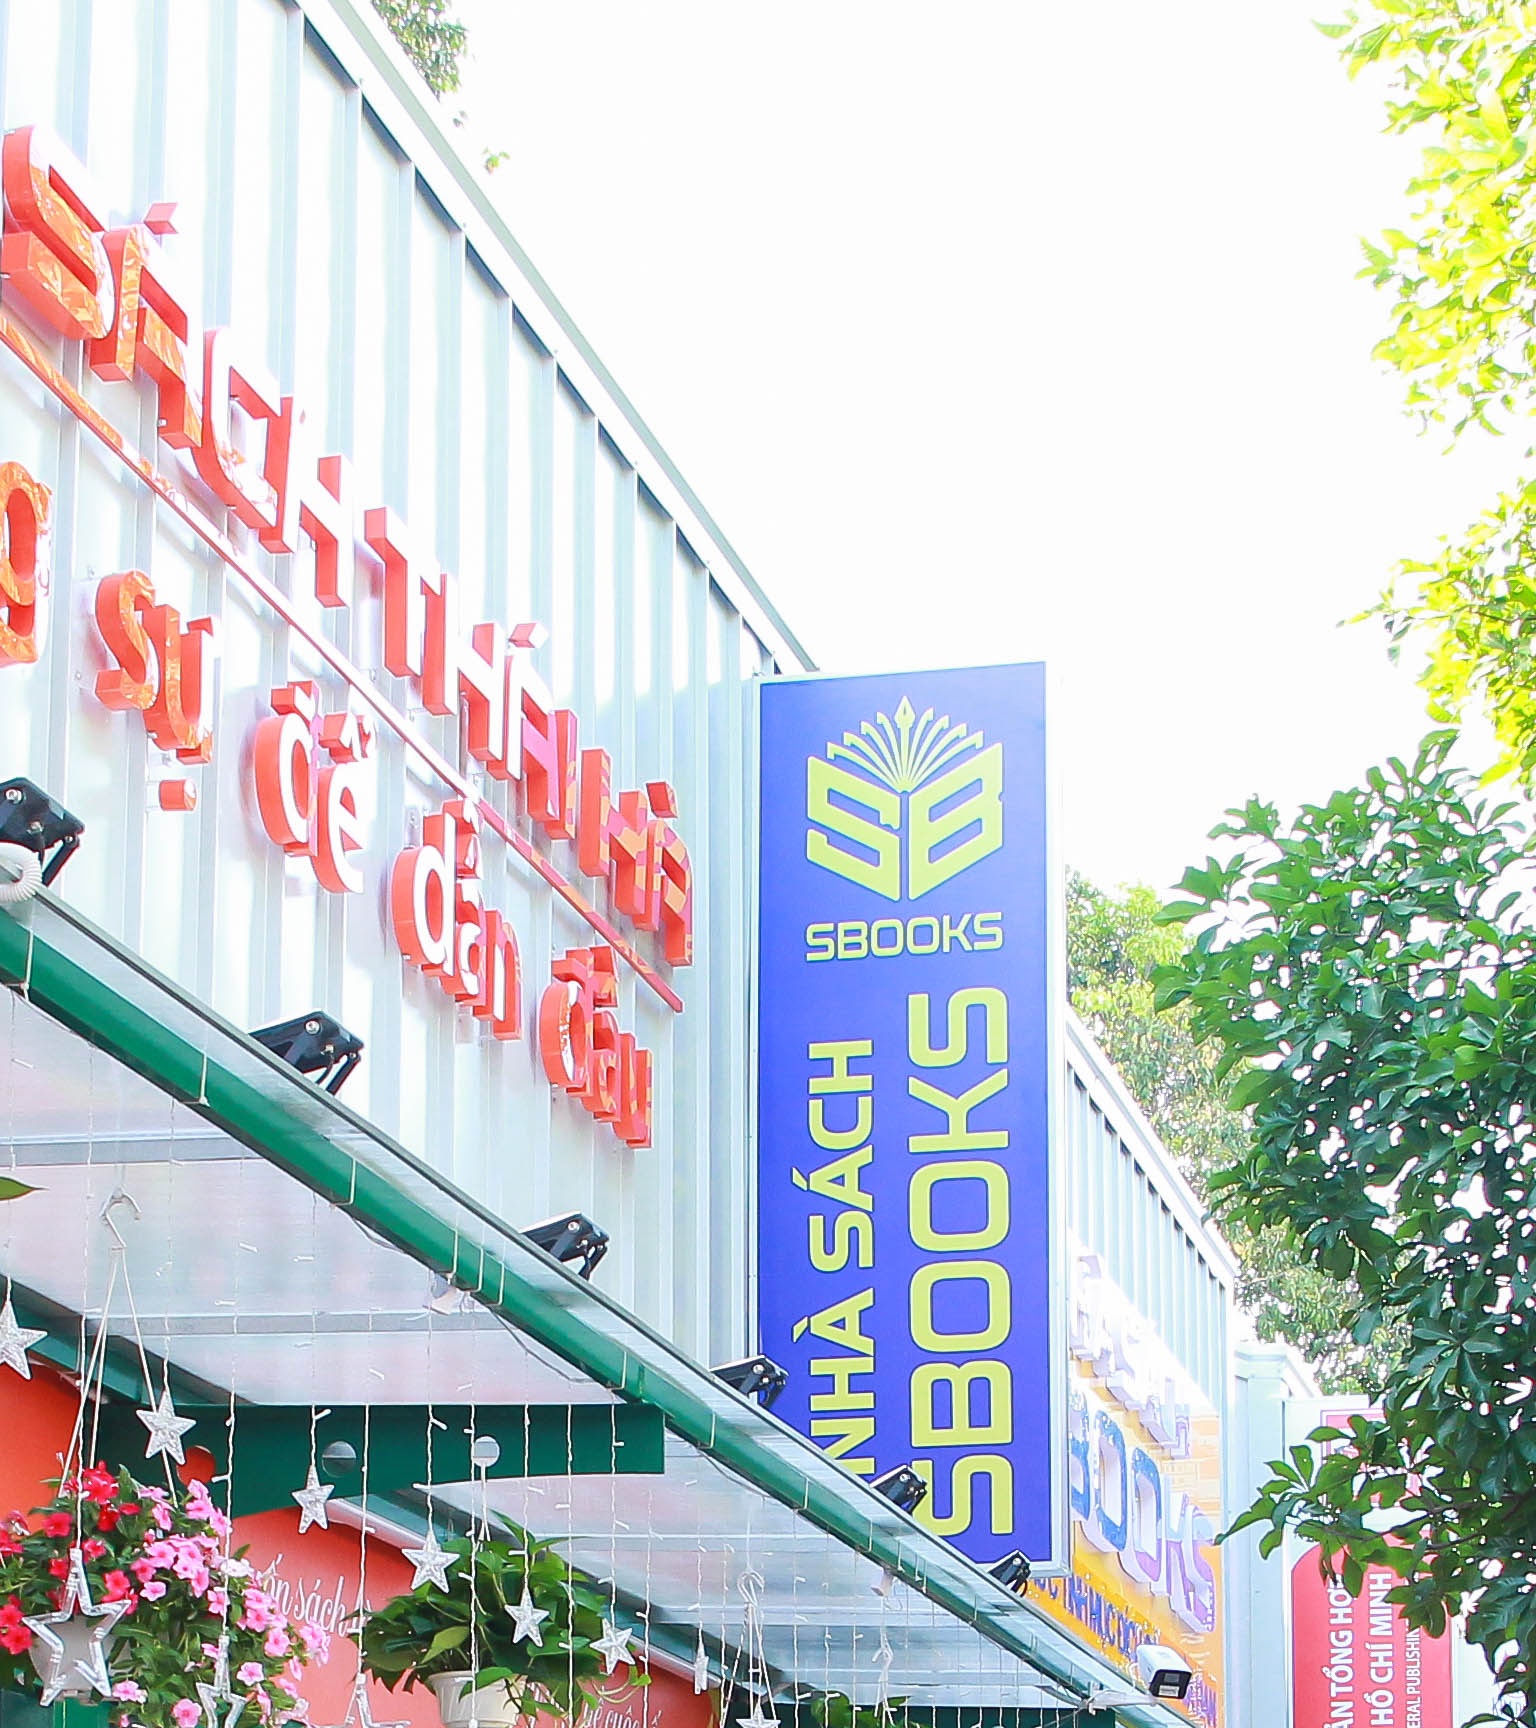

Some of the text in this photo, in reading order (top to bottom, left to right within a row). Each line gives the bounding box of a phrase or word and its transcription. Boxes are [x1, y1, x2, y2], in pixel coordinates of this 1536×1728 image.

[0, 120, 352, 608] SÁCH
[94, 568, 215, 812] sự
[254, 681, 376, 895] để
[390, 798, 523, 1041] dẫn
[805, 911, 1005, 963] SBOOKS
[793, 1038, 875, 1475] NHÀ SÁCH
[907, 986, 1013, 1535] SBOOKS
[295, 1576, 345, 1635] sách
[1368, 1572, 1393, 1637] MINH
[1322, 1630, 1355, 1698] TỔNG
[1365, 1641, 1394, 1685] CHÍ
[1404, 1626, 1422, 1695] PUBLISHIN
[1364, 1689, 1395, 1726] HỒ
